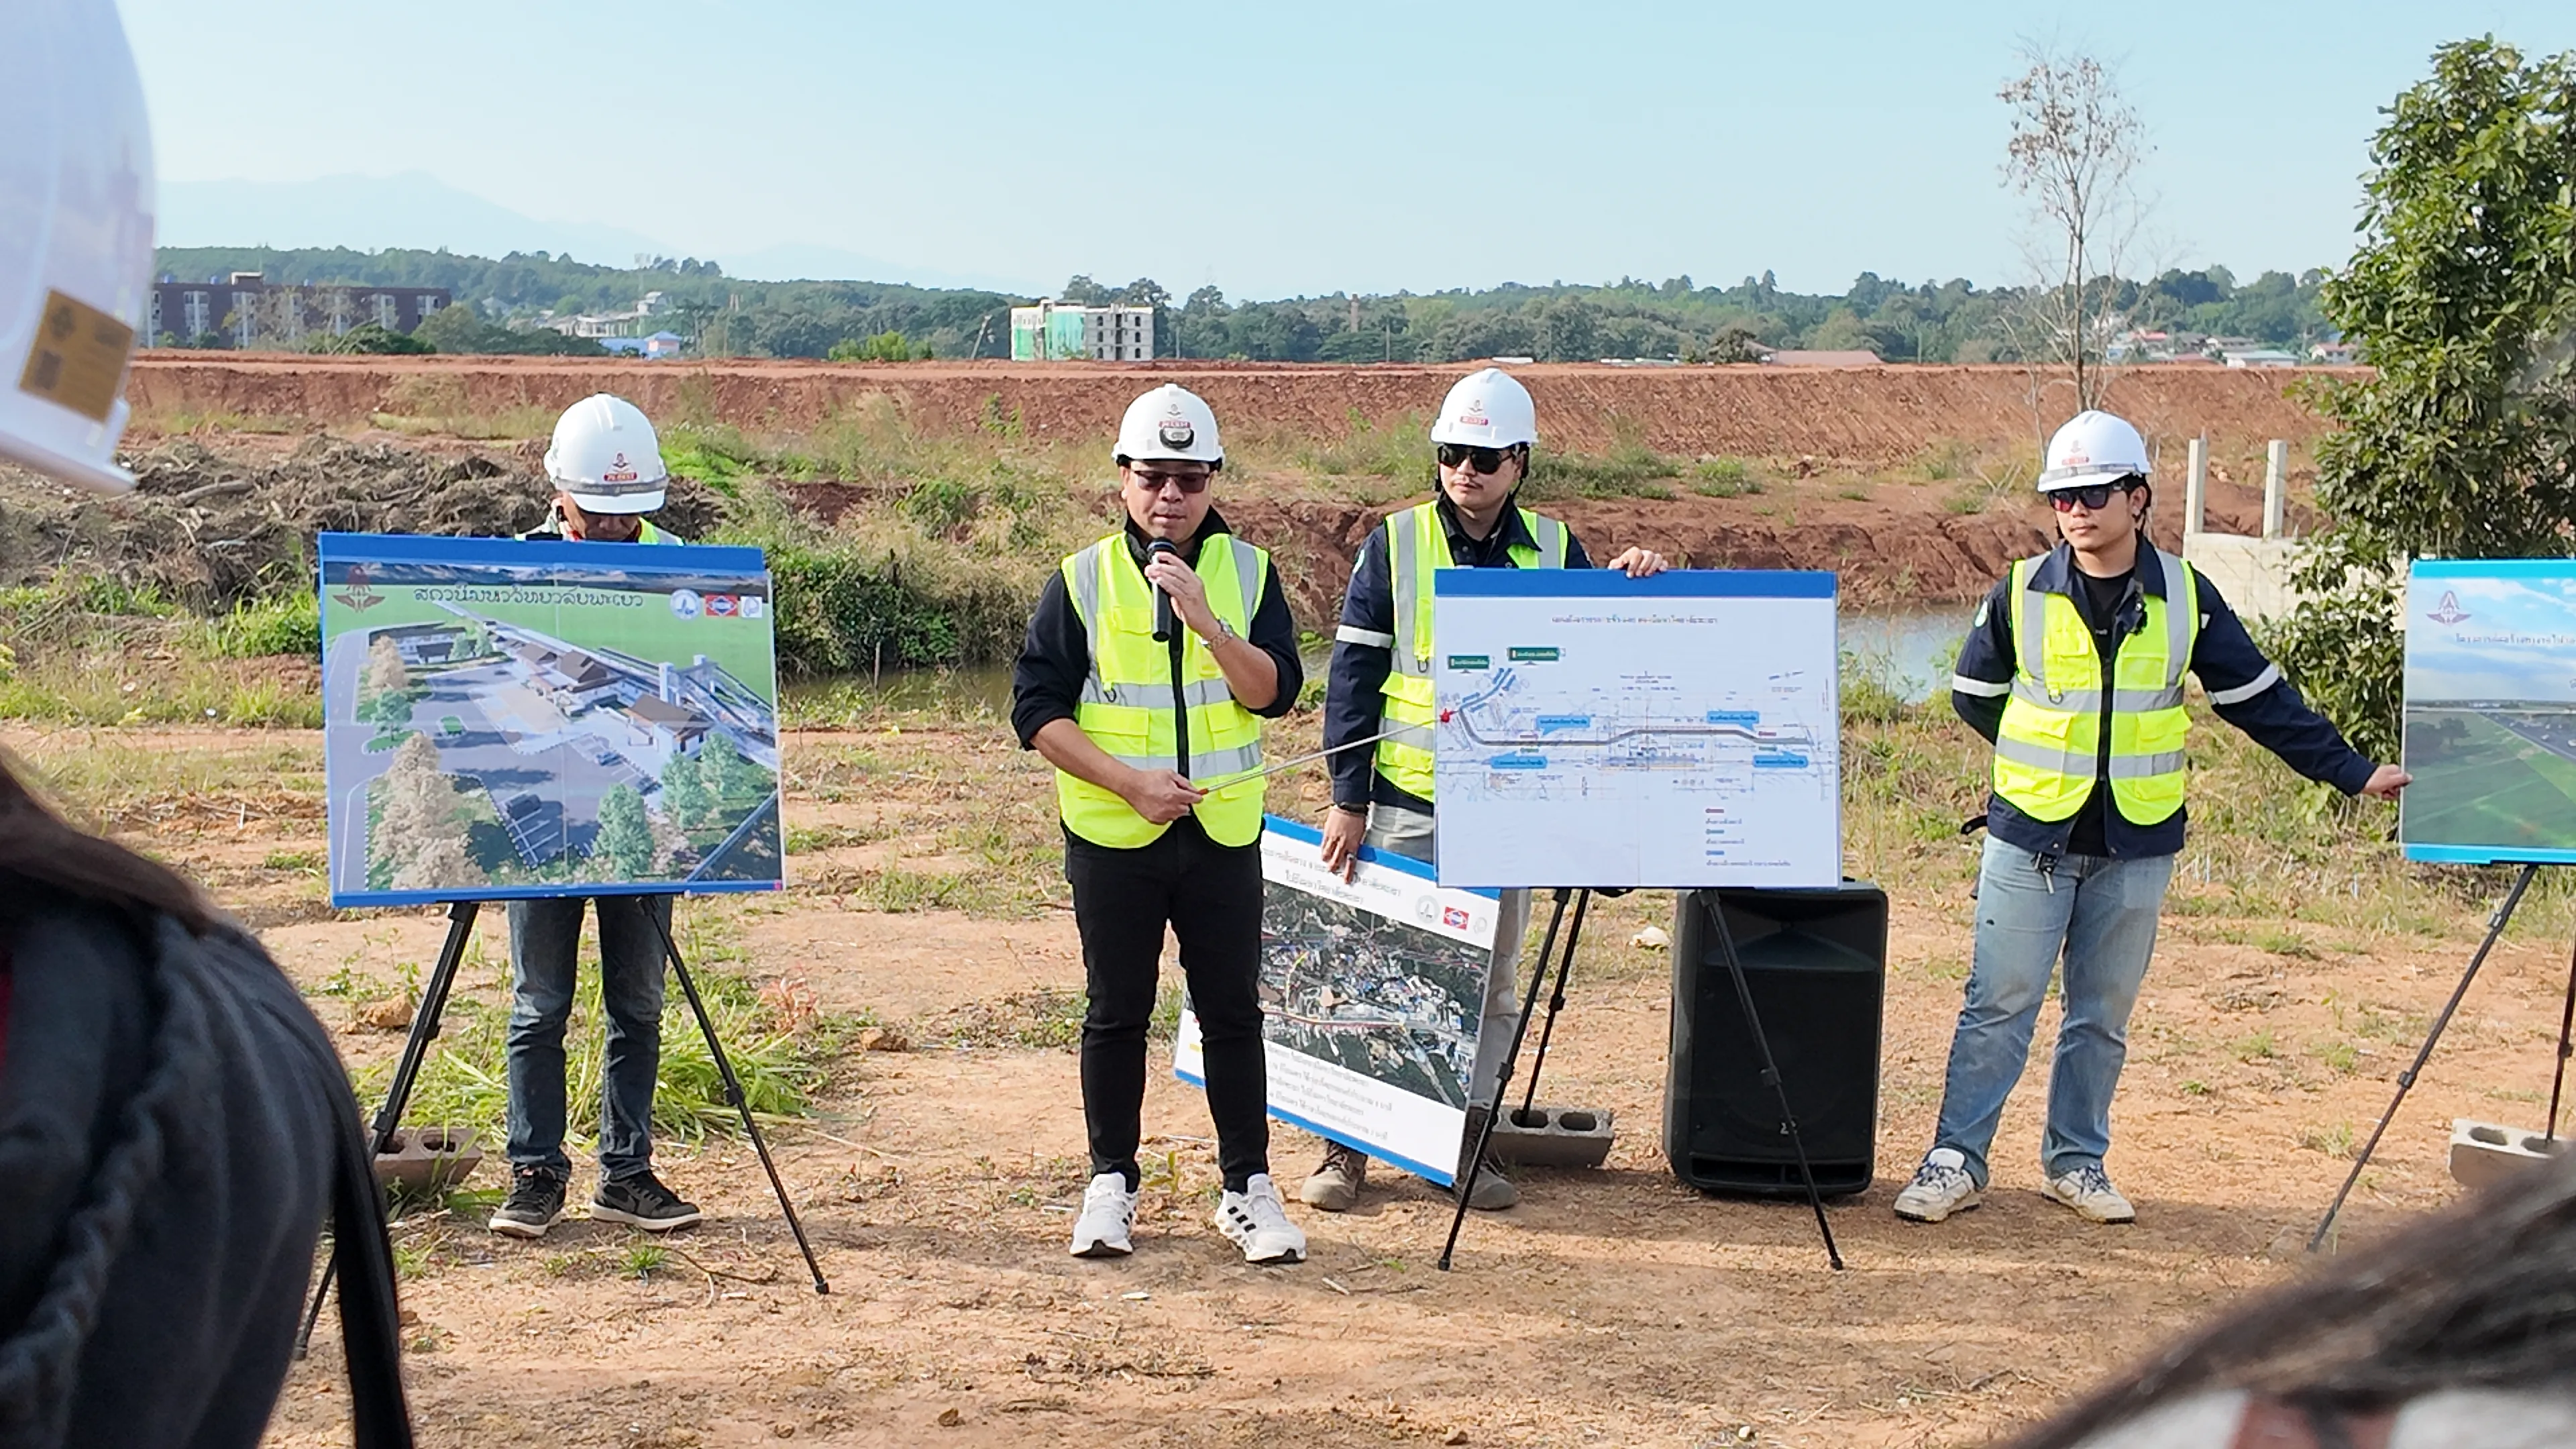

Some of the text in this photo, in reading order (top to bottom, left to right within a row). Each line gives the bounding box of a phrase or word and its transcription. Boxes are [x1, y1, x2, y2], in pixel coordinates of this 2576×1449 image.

[413, 582, 644, 607] สถานีมหาวิทยาลัยพะเยา
